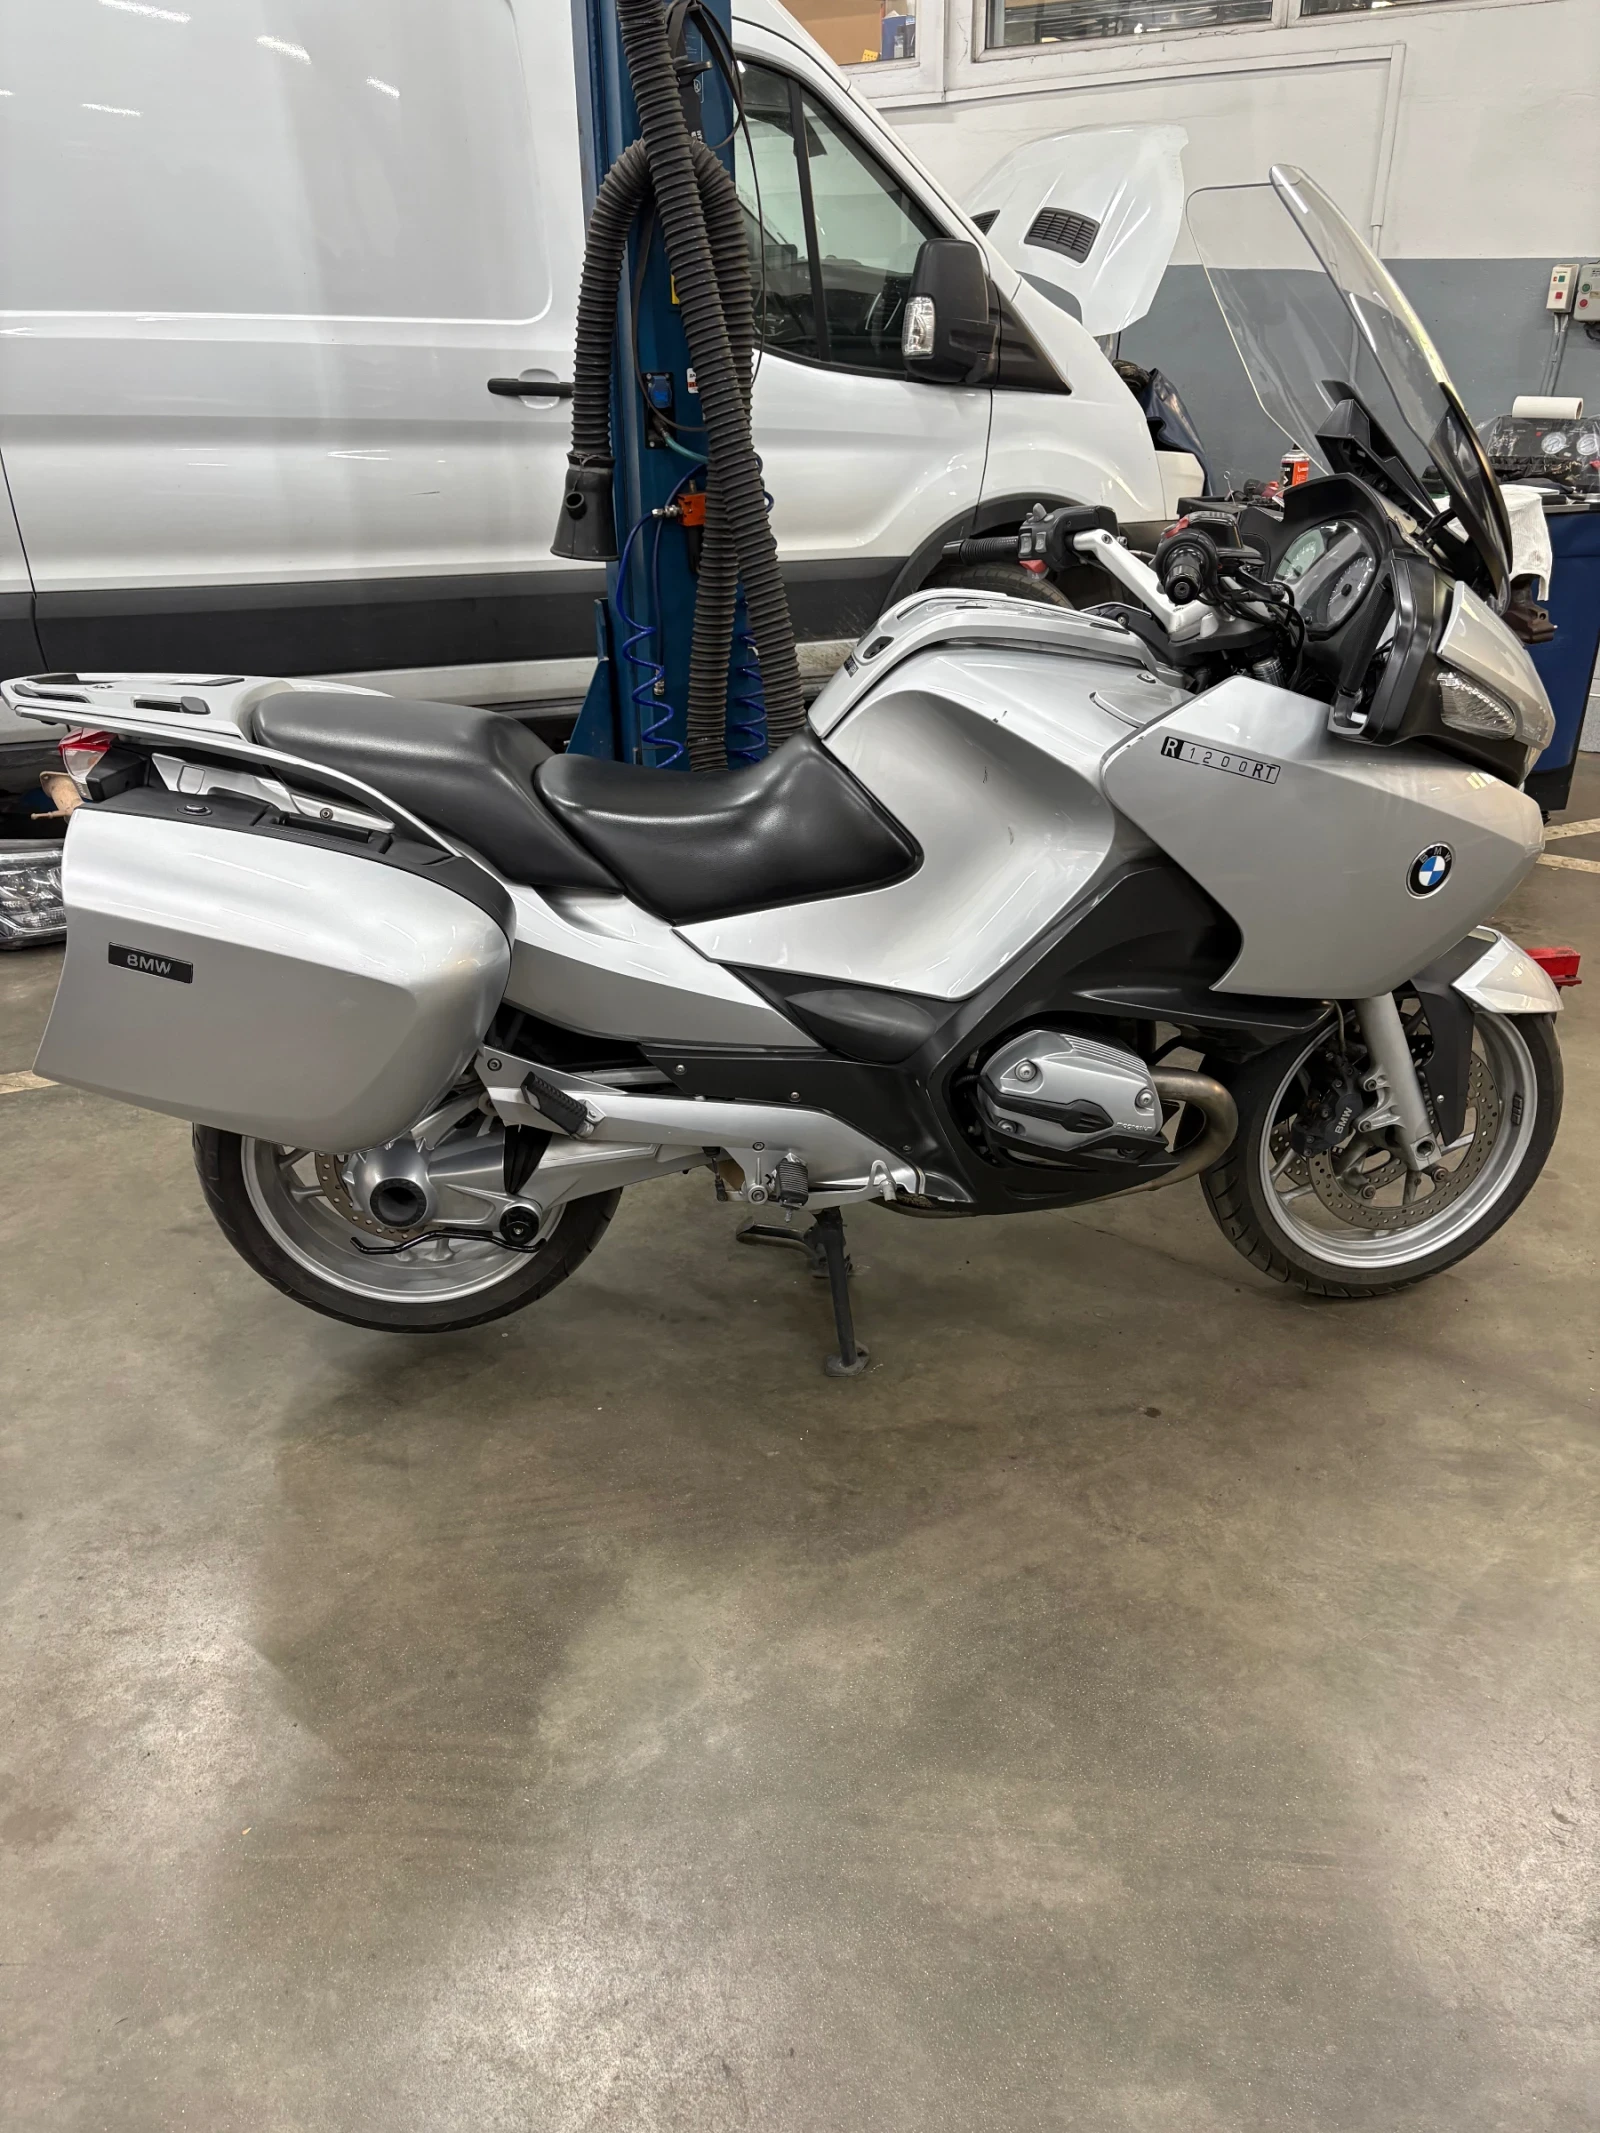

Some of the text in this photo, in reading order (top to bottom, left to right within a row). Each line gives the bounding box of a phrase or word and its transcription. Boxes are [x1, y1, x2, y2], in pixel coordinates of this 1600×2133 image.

[1419, 846, 1452, 864] BMW
[127, 954, 171, 975] BMW
[1335, 1106, 1353, 1134] BMW
